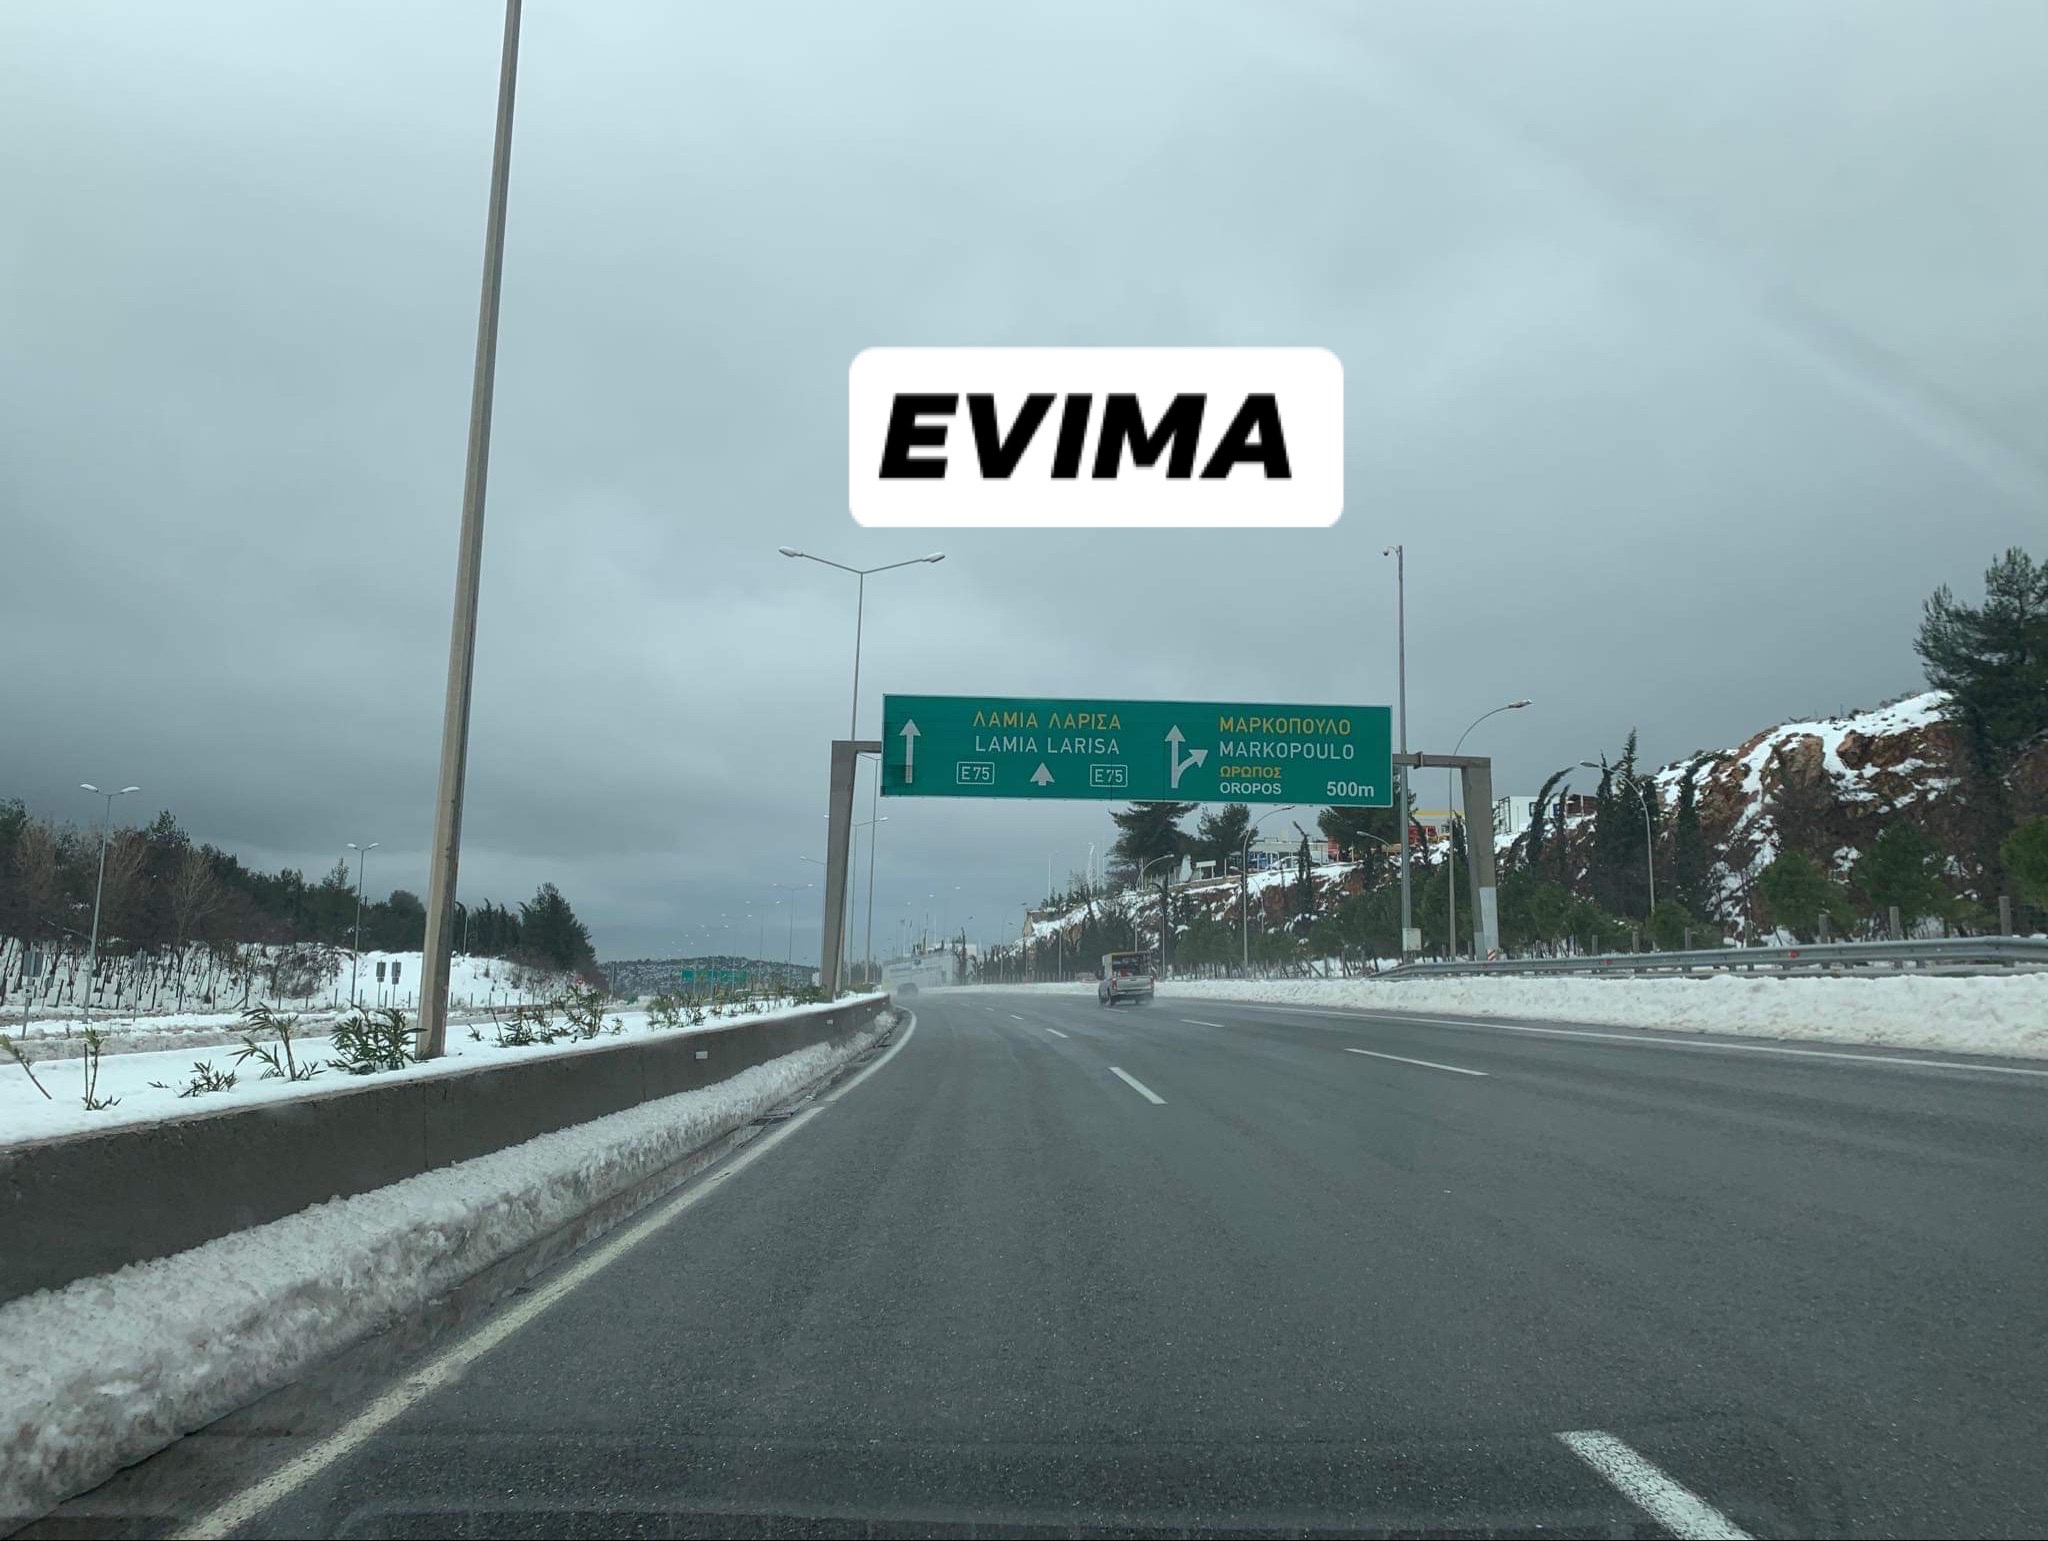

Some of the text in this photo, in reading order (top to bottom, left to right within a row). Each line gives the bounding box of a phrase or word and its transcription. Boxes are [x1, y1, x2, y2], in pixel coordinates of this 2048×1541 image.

[973, 711, 1121, 730] ΛΑΜΙΑ ΛΑΡΙΣΑ
[1219, 716, 1351, 735] ΜΑΡΚΟΠΟΥΛΟ
[975, 735, 1120, 755] LAMIA LARISA
[1219, 741, 1354, 760] MARKOPOULO
[1220, 765, 1282, 779] ΩΡΩΠΟΣ
[1220, 781, 1282, 795] OROPOS
[1326, 781, 1375, 797] 500m
